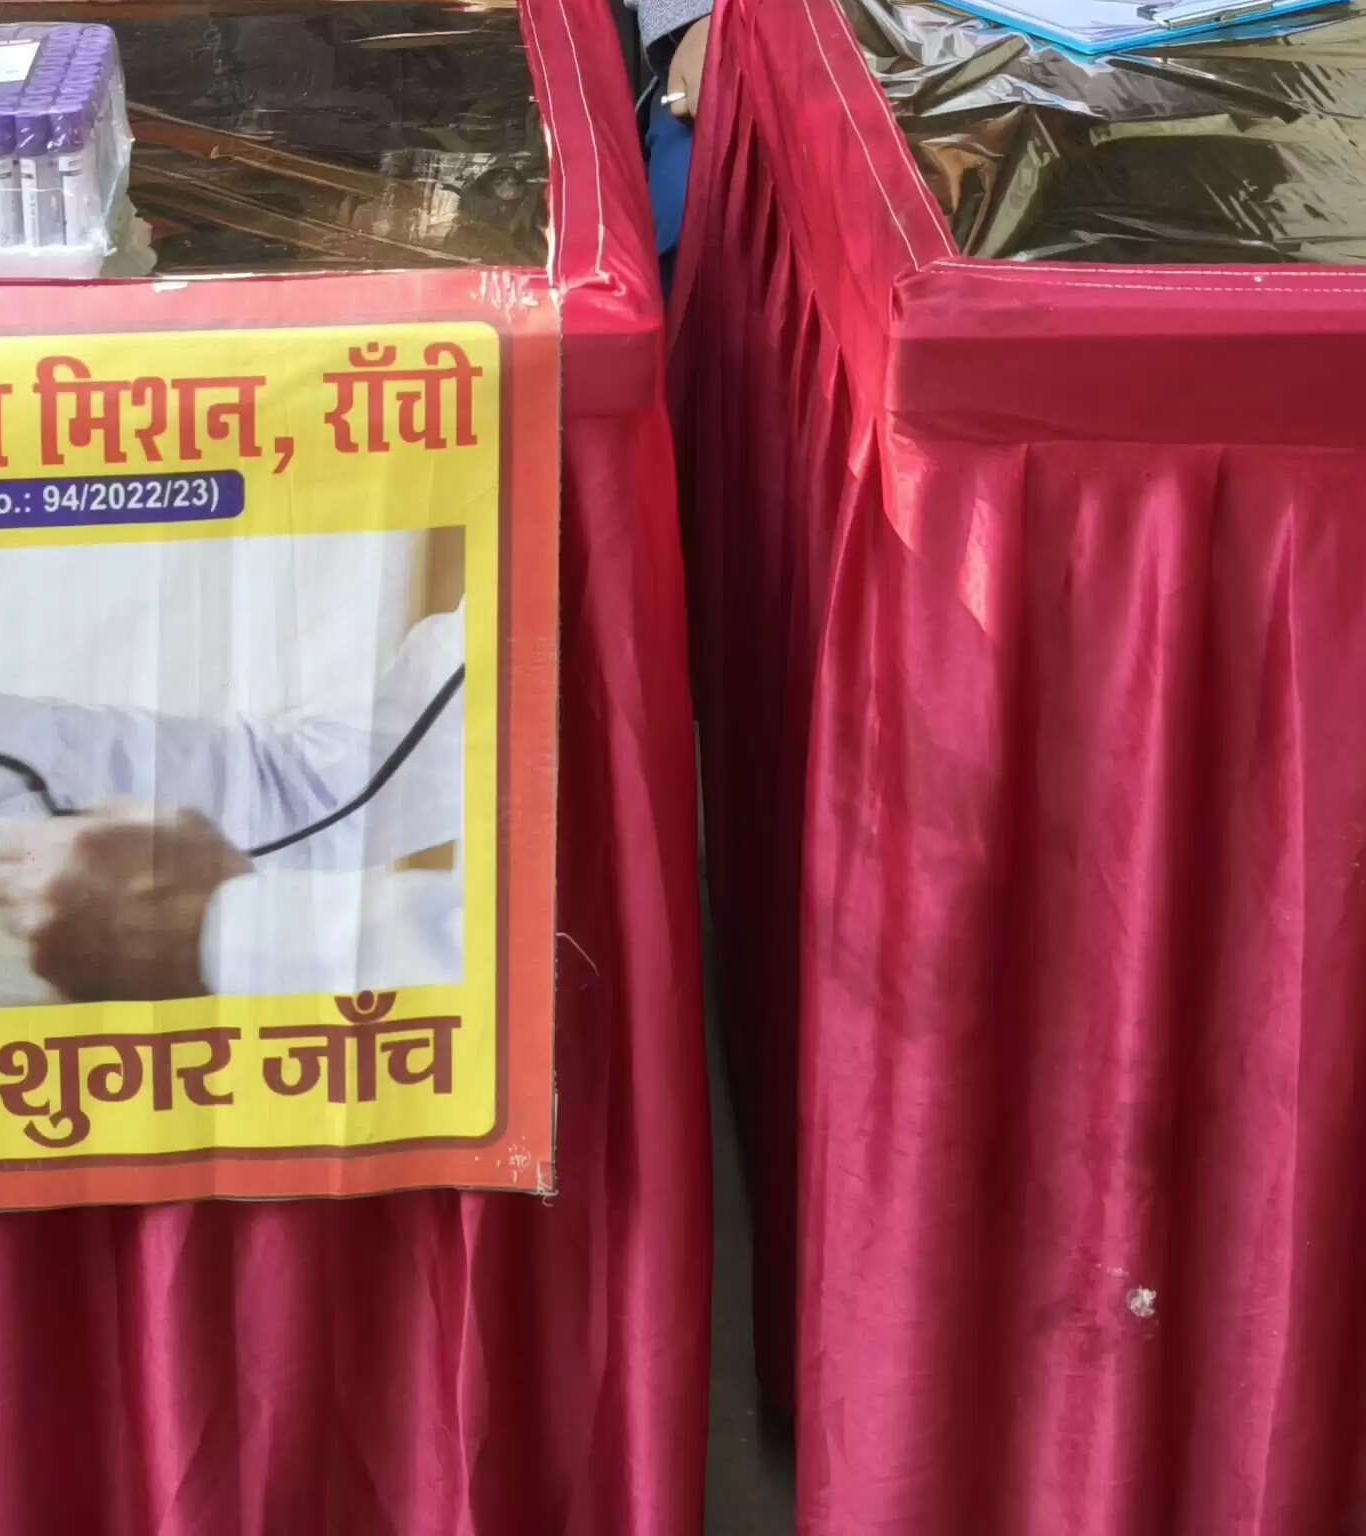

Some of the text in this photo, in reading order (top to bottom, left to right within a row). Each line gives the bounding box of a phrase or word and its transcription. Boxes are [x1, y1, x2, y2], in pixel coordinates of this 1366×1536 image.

[32, 355, 295, 474] मिशन,
[323, 341, 482, 455] राँची
[43, 477, 219, 514] 94/2022/23)
[259, 990, 461, 1105] जाँच
